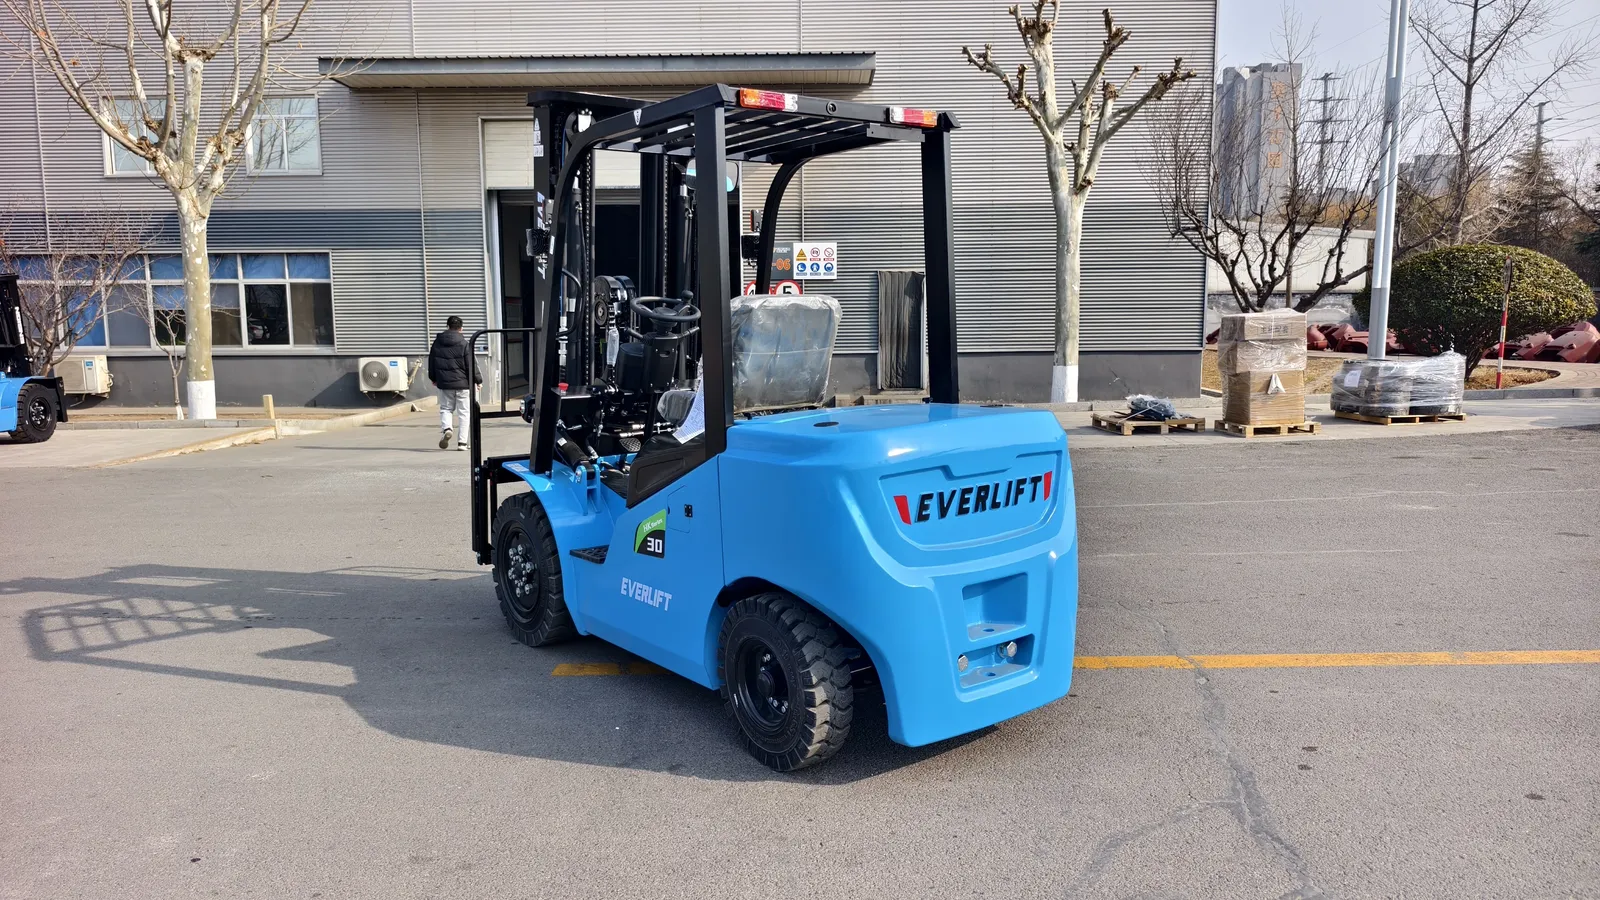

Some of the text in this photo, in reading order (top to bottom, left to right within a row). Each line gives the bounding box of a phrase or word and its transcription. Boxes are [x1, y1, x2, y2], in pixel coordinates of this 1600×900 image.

[914, 475, 1042, 523] EVERLIFT
[643, 521, 652, 532] HK
[647, 537, 662, 553] 30
[620, 577, 672, 611] EVERLIFT
